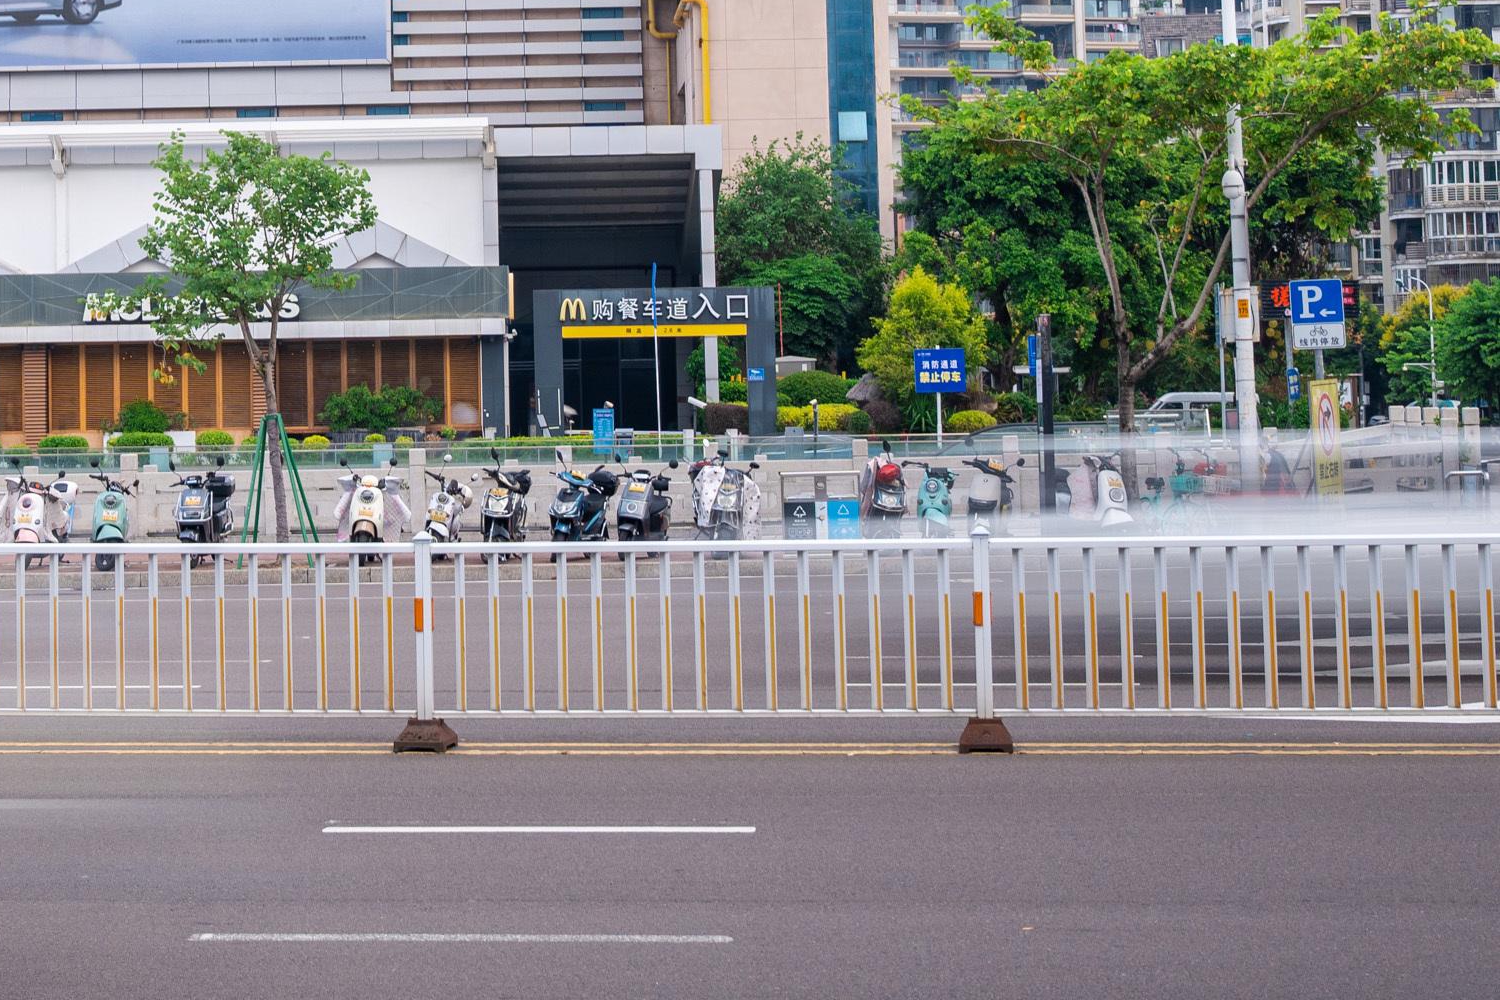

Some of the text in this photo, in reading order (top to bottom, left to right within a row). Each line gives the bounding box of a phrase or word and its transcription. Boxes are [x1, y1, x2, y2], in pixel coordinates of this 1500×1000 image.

[592, 292, 749, 321] 购餐车道入口
[1297, 285, 1323, 319] P
[1299, 336, 1340, 347] 线内停放
[921, 359, 958, 370] 消防通道
[919, 371, 962, 384] 禁止停车
